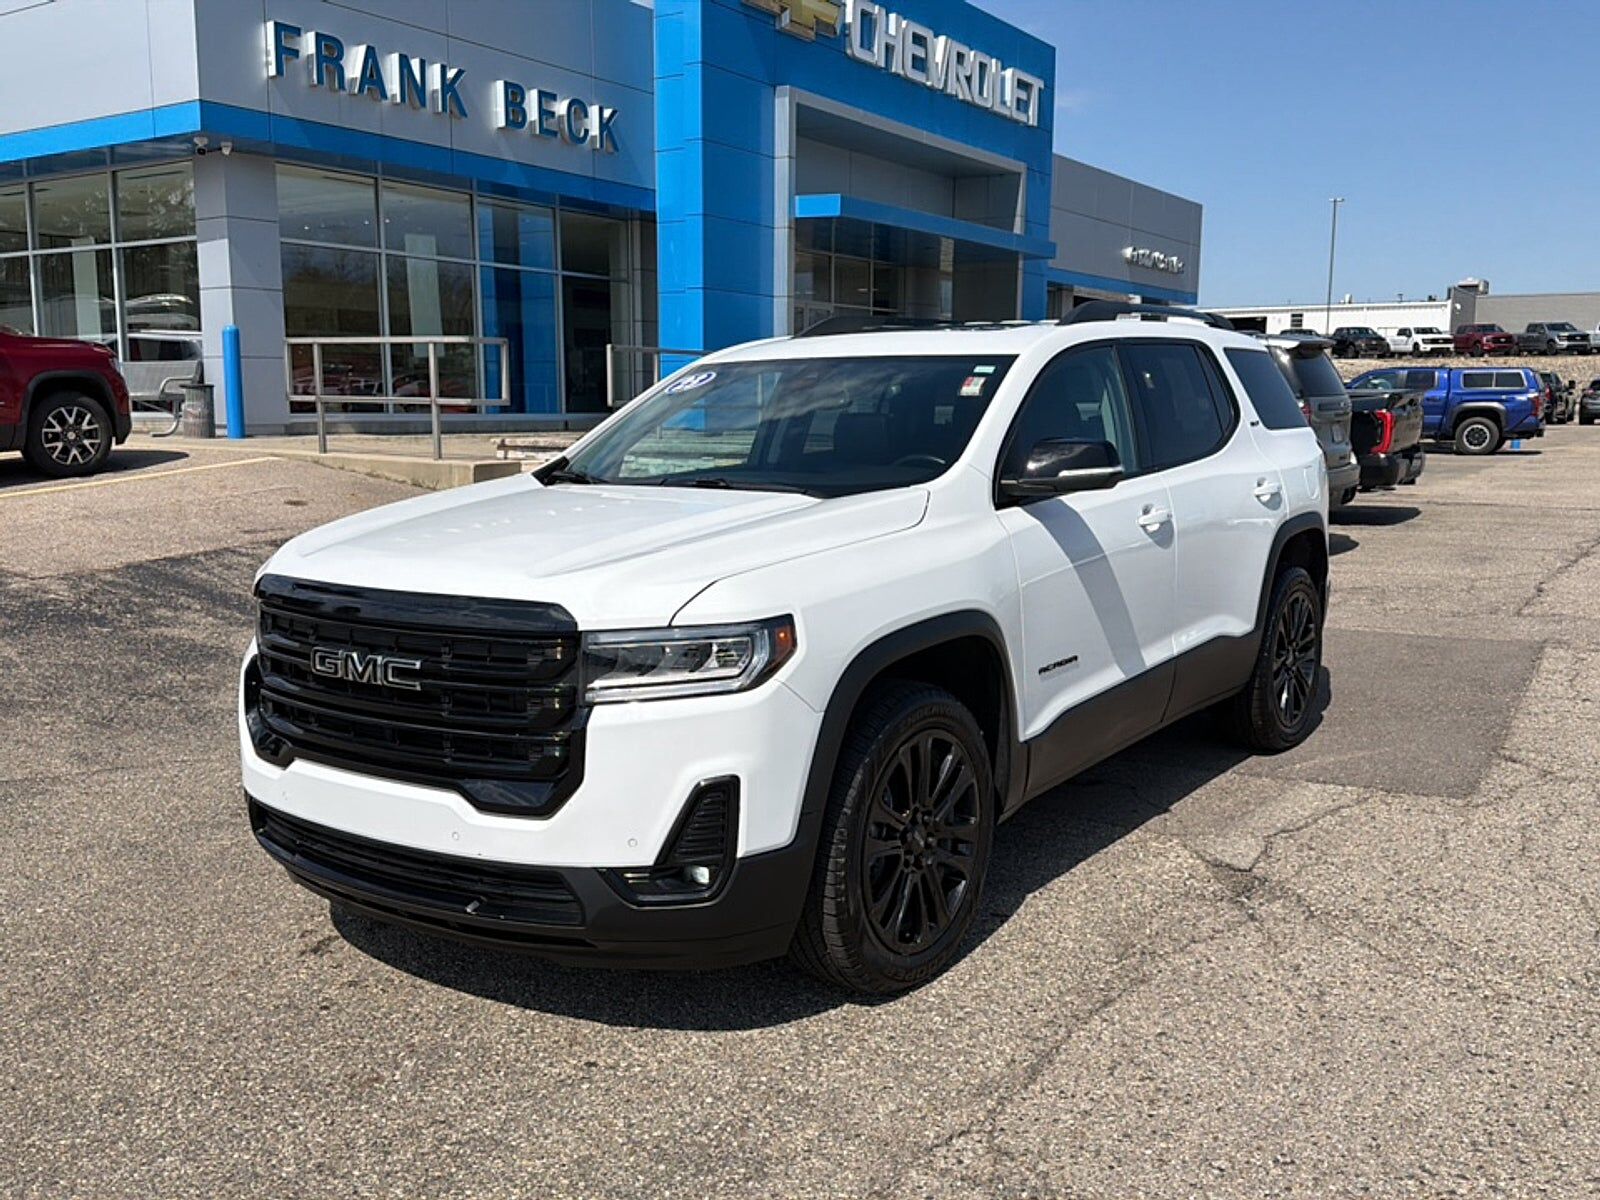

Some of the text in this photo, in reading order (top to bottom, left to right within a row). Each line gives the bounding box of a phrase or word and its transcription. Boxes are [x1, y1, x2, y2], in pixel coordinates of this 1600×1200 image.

[266, 20, 620, 153] FRANK BECK
[845, 0, 1044, 126] CHEVROLET
[311, 646, 421, 691] GMC
